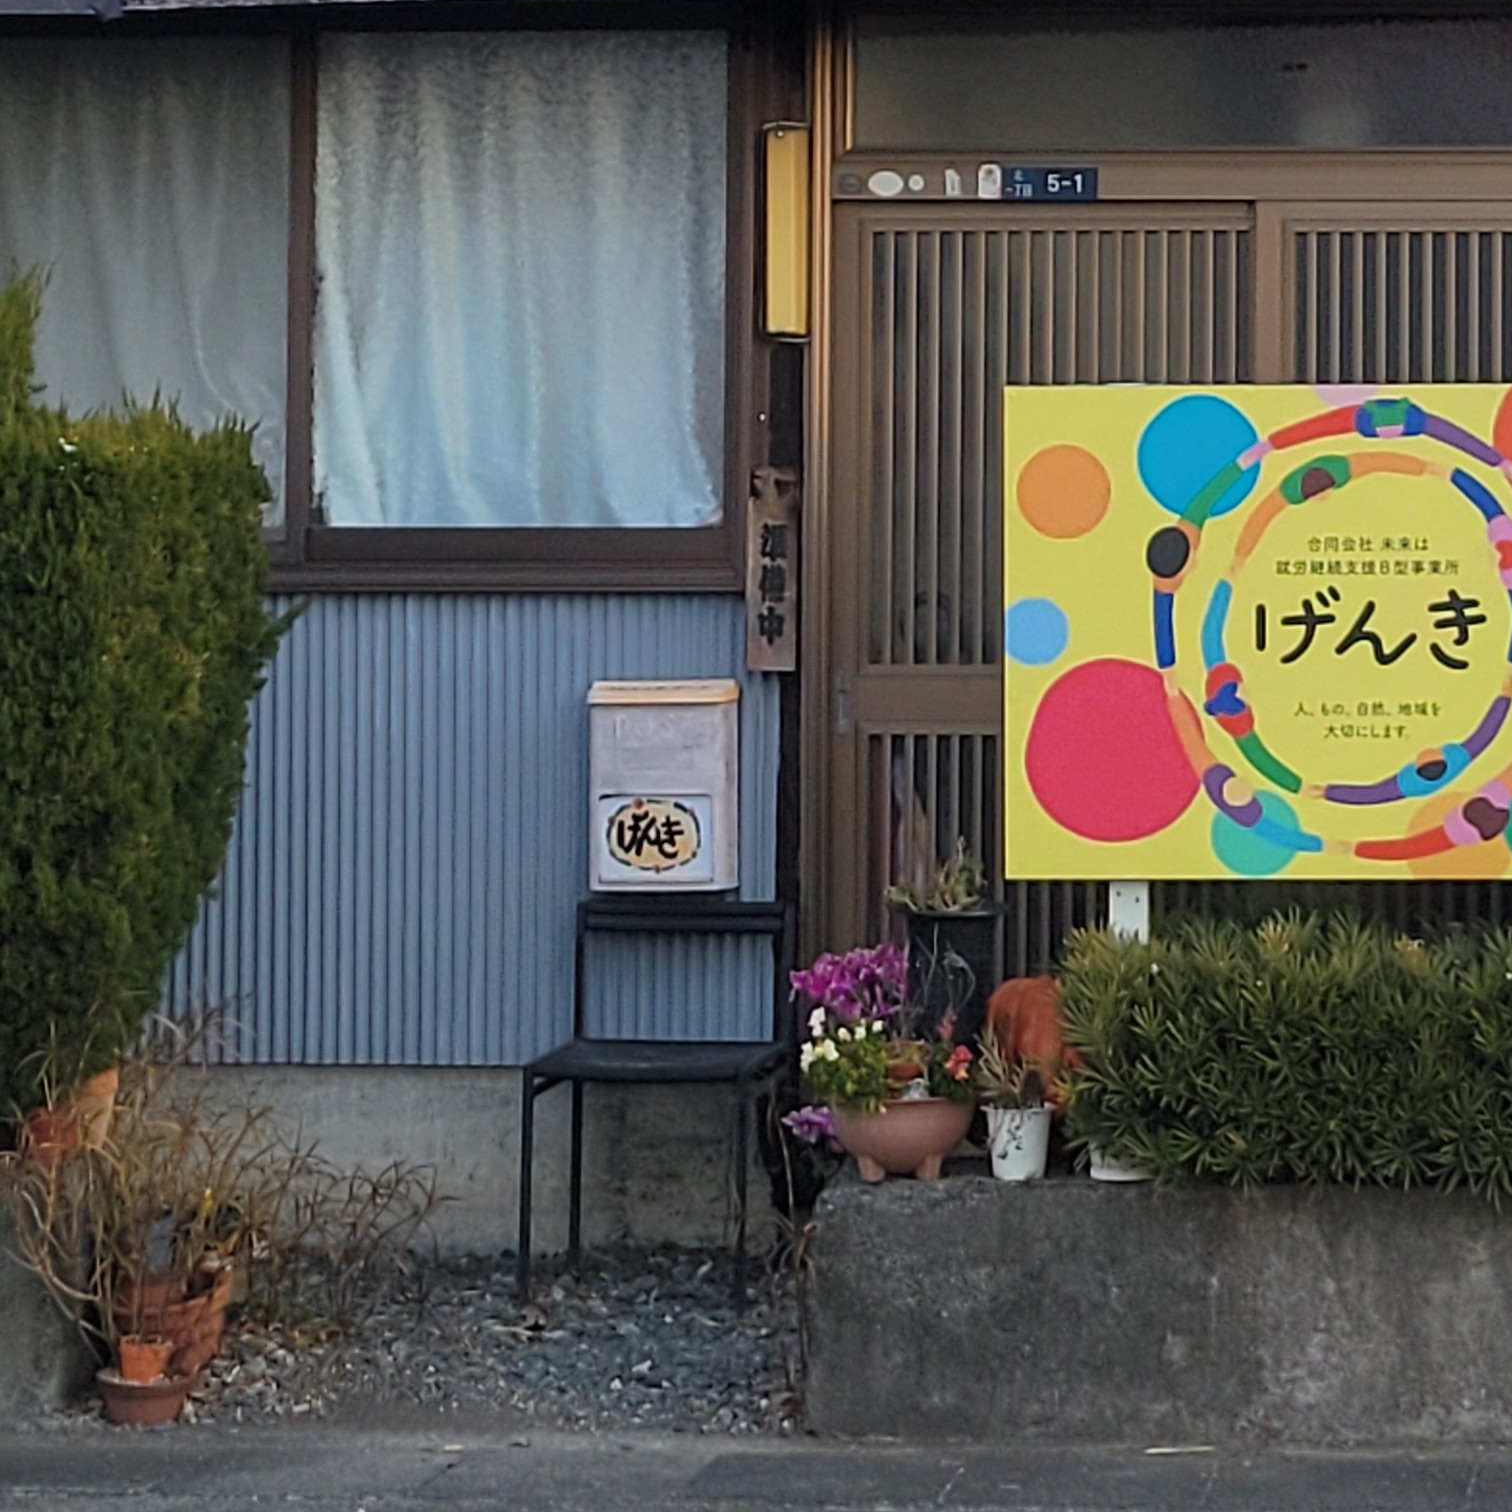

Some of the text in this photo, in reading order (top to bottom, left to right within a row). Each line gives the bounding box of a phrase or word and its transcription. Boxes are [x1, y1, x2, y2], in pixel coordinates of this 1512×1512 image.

[1047, 173, 1082, 193] 5-1
[1307, 536, 1429, 553] 合同会社 未来は
[1275, 559, 1459, 576] 就労継続支援B型事業所
[1255, 585, 1487, 670] げんき
[617, 809, 684, 859] げんき
